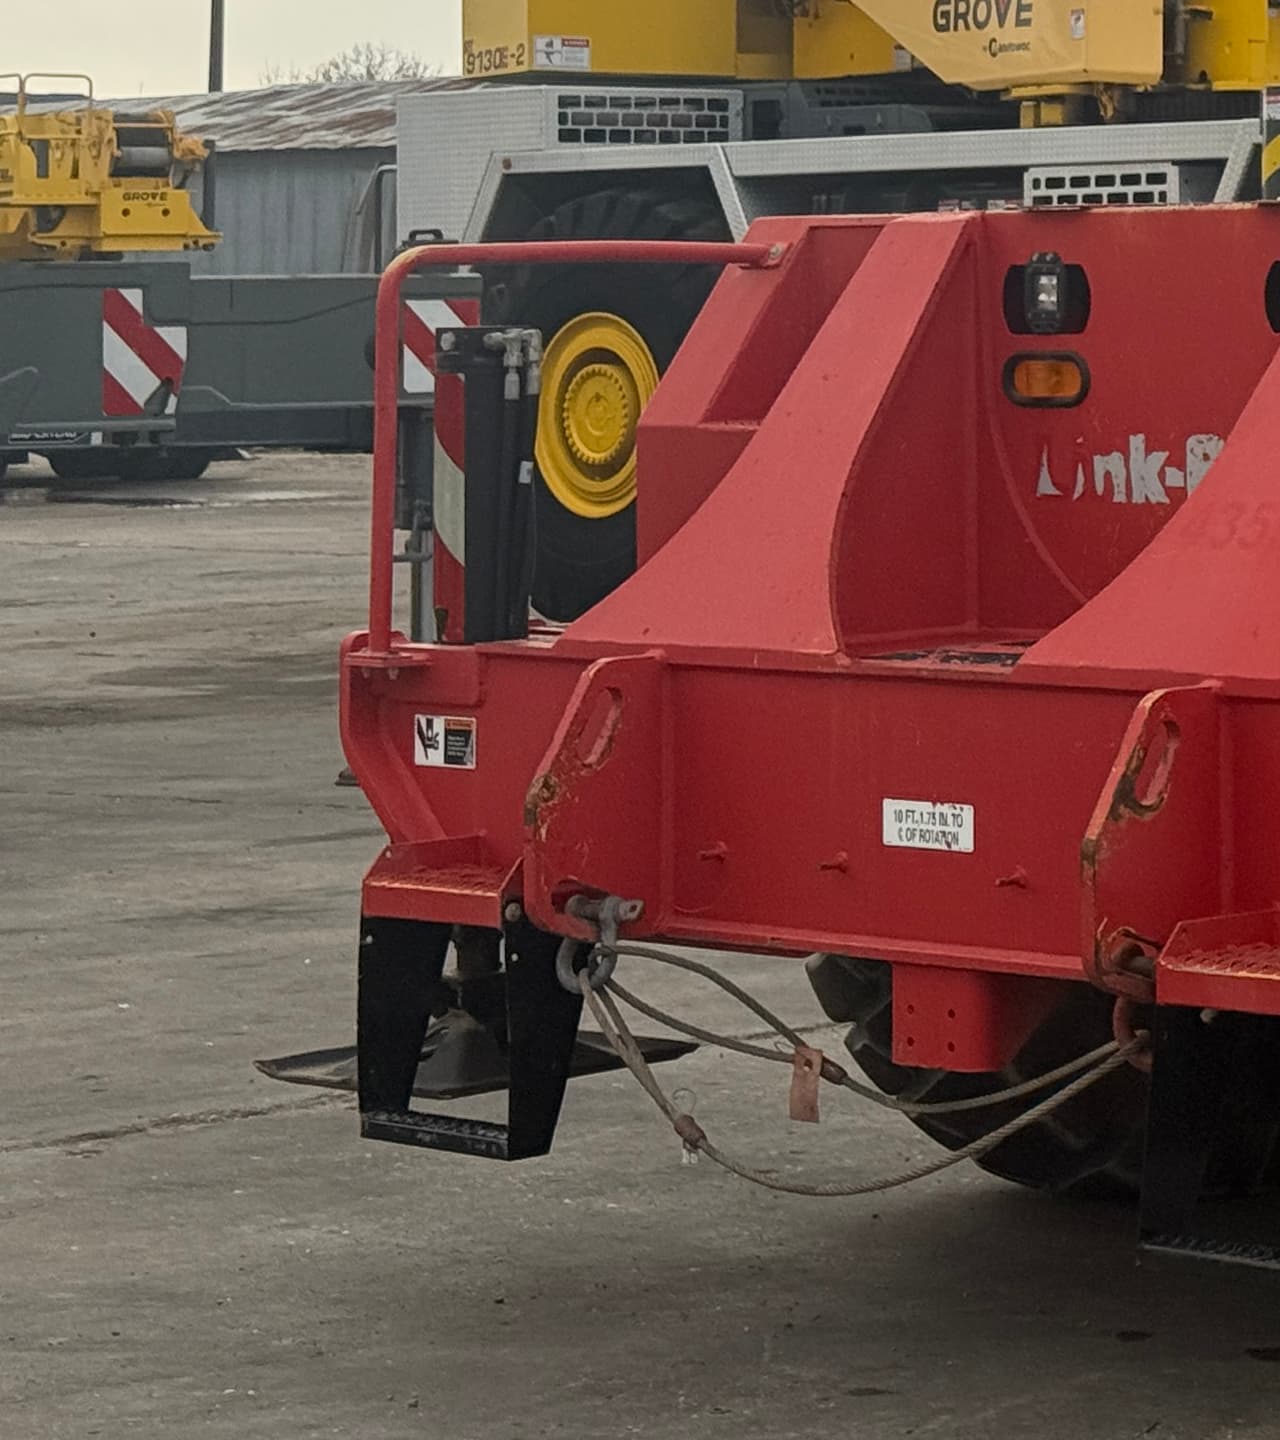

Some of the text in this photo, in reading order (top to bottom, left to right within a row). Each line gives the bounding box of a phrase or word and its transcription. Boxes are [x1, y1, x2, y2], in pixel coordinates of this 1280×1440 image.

[122, 191, 168, 201] GROVE
[894, 809, 903, 823] 10
[905, 809, 919, 824] FT.
[920, 811, 936, 826] 1.75
[951, 813, 964, 828] TO
[905, 827, 917, 842] OF
